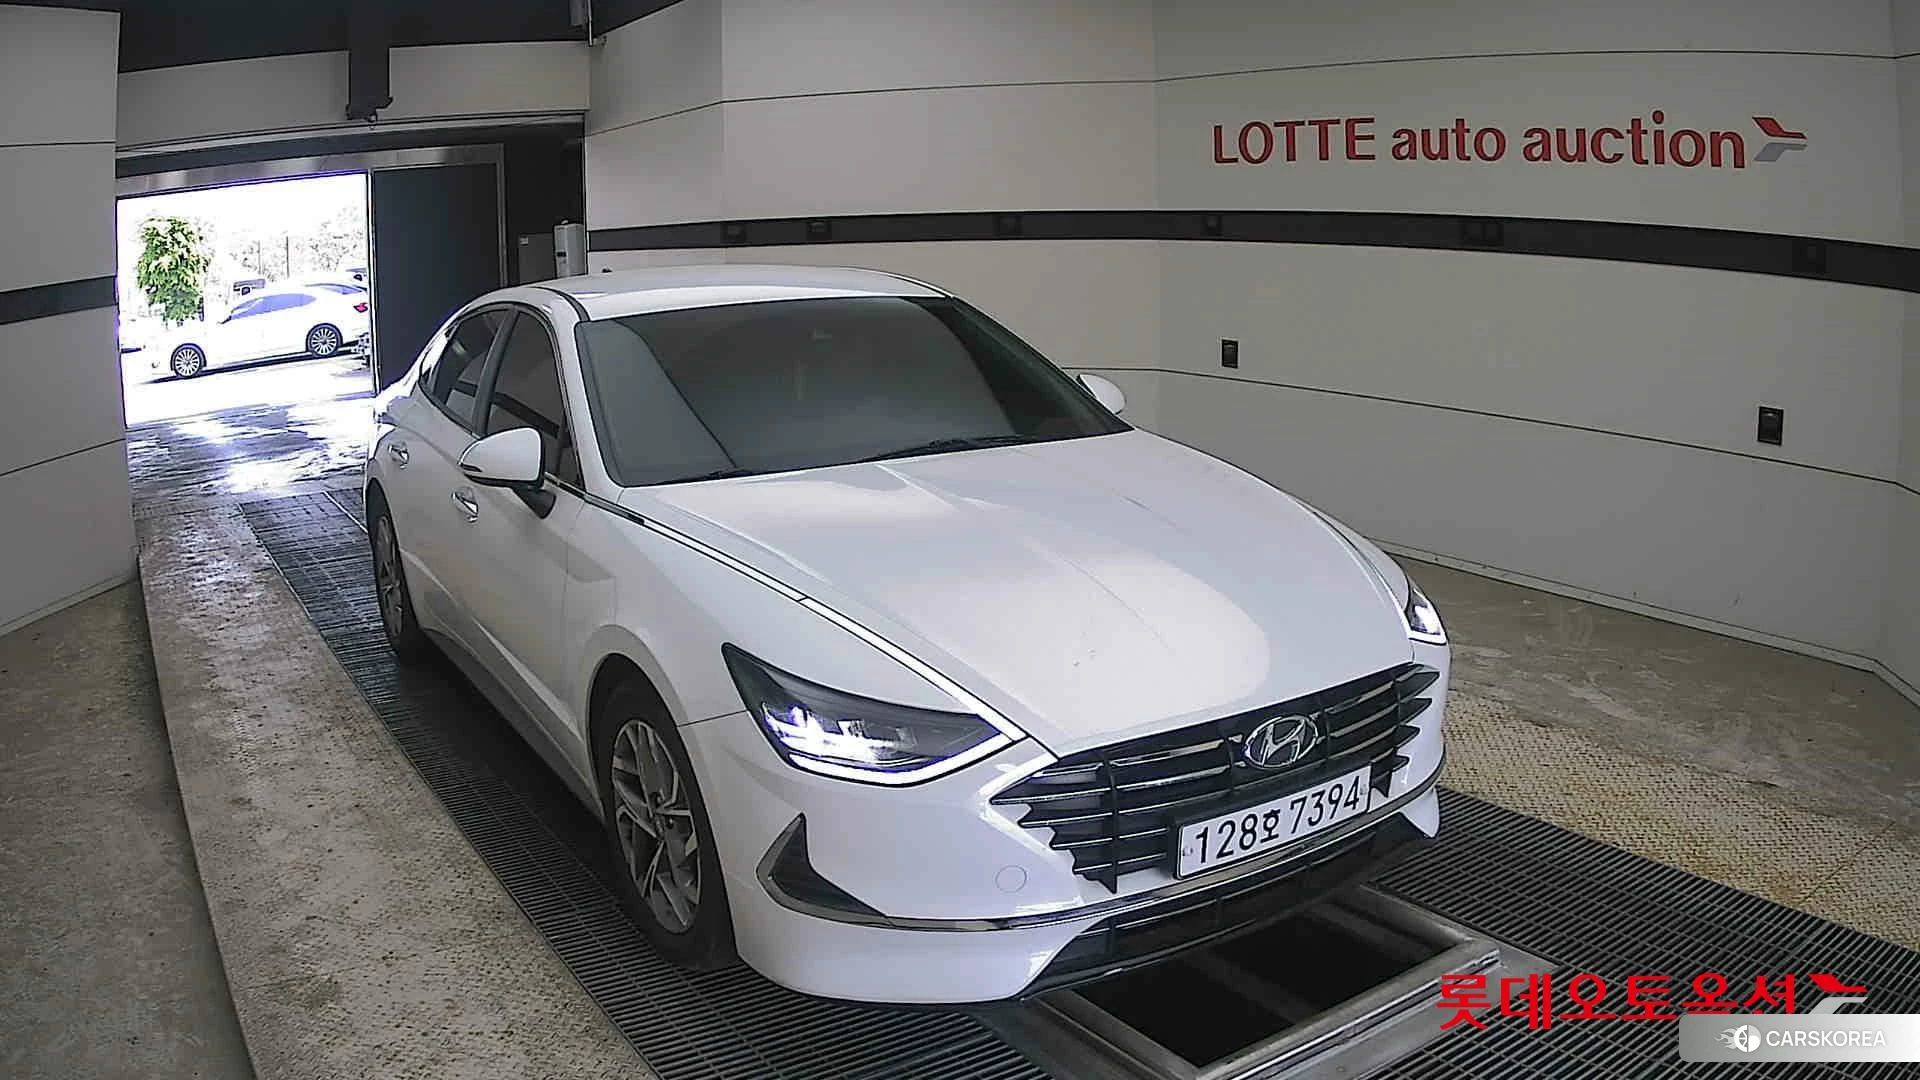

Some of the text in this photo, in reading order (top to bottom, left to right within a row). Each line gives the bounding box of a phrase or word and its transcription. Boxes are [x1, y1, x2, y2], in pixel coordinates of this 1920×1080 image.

[1212, 109, 1746, 169] LOTTE auto auction
[1195, 775, 1360, 864] 128호 7394
